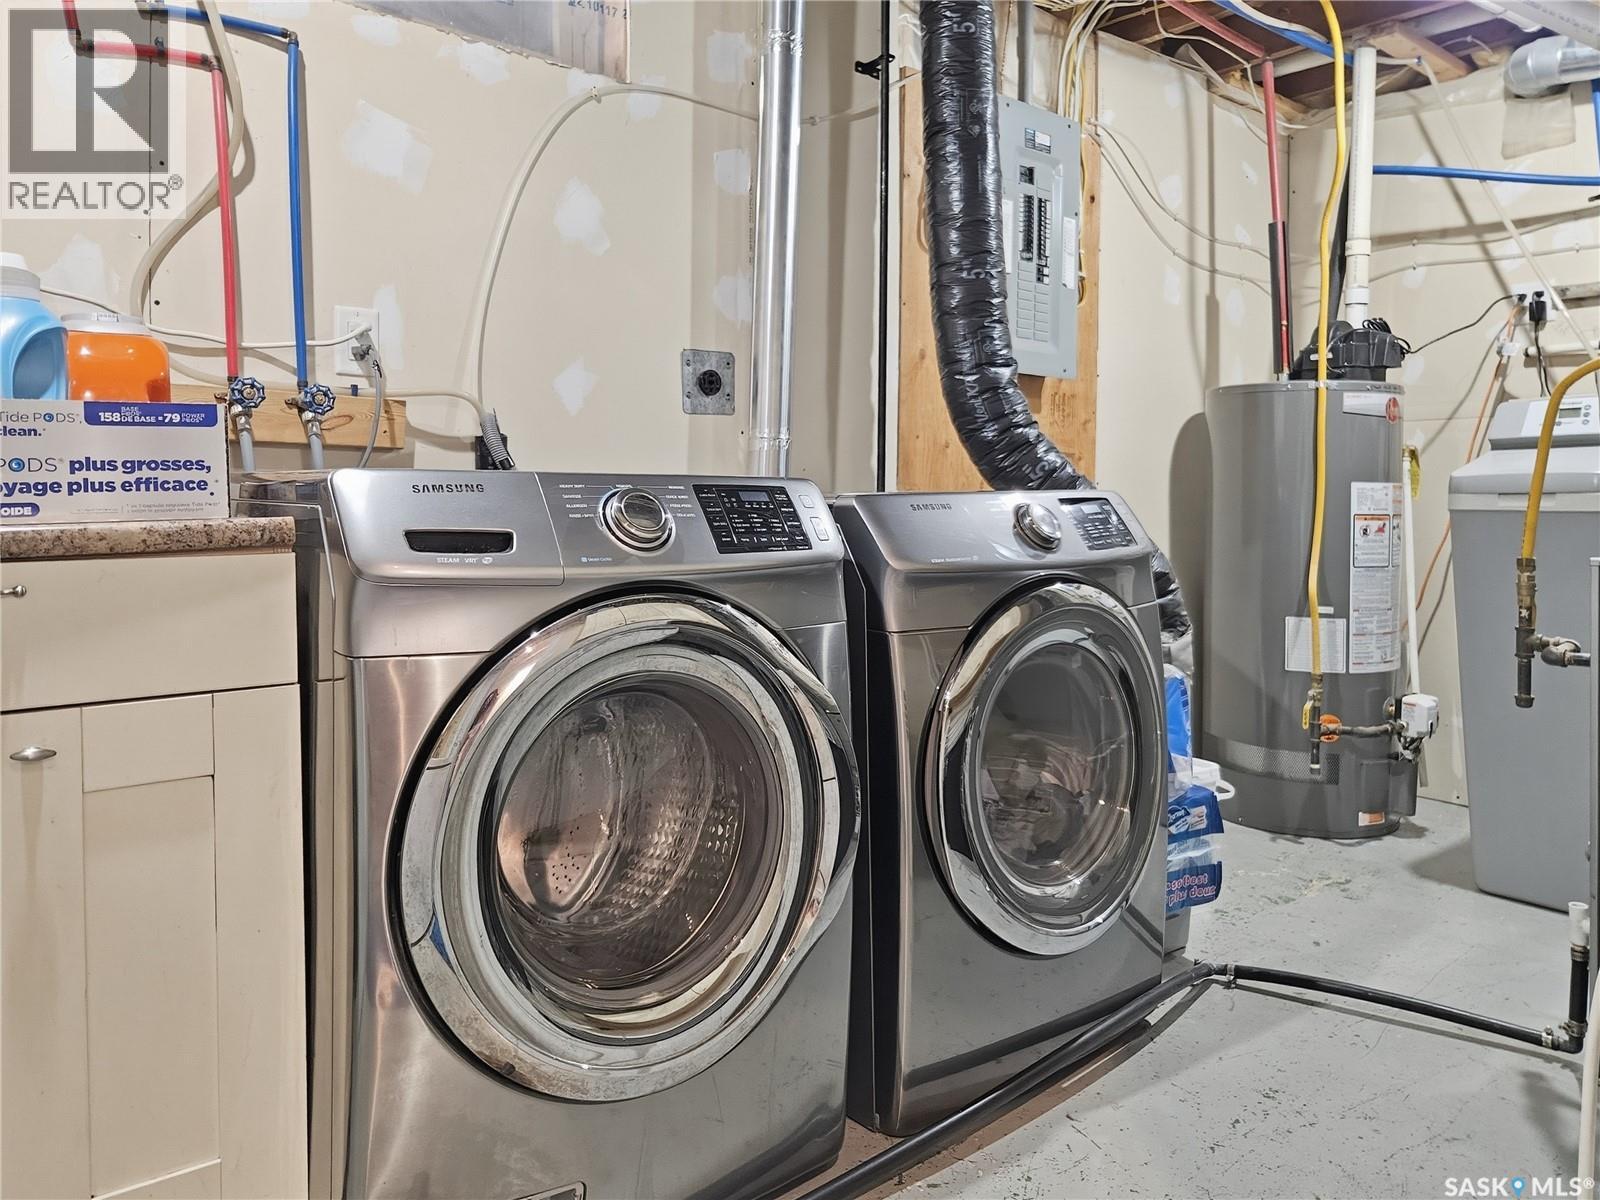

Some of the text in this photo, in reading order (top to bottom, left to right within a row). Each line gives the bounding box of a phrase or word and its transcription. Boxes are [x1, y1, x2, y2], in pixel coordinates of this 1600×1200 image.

[99, 411, 121, 422] 158
[164, 413, 180, 423] 79
[69, 456, 119, 475] plus
[121, 459, 212, 475] grosses,
[0, 480, 62, 498] yage
[67, 477, 116, 496] plus
[411, 483, 485, 493] SAMSUNG
[910, 503, 952, 512] SAMSUNG
